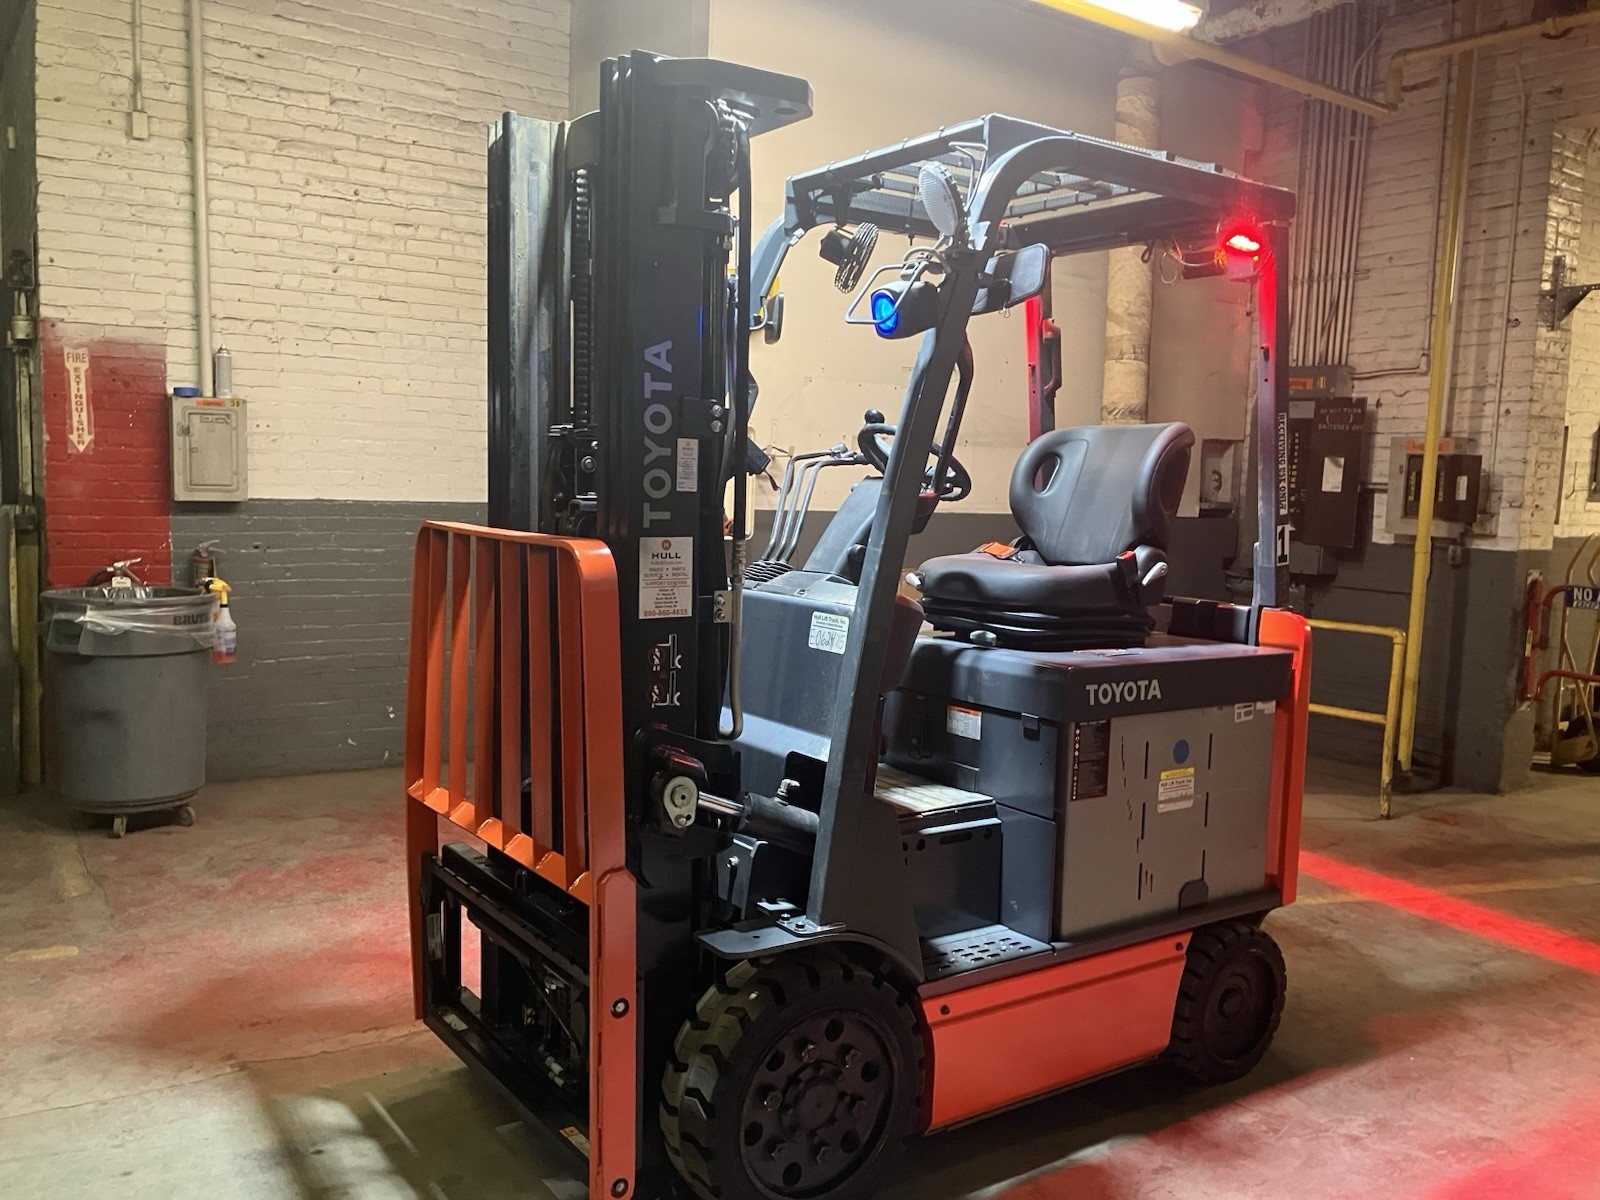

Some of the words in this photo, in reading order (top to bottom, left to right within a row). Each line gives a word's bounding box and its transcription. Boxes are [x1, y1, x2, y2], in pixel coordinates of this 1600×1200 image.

[66, 352, 88, 364] FIRE
[73, 367, 85, 446] EXTINGUISHER
[643, 340, 673, 528] TOYOTA
[651, 552, 681, 560] HULL
[1278, 526, 1288, 564] 1
[1573, 587, 1593, 601] NO
[1086, 679, 1162, 706] TOYOTA
